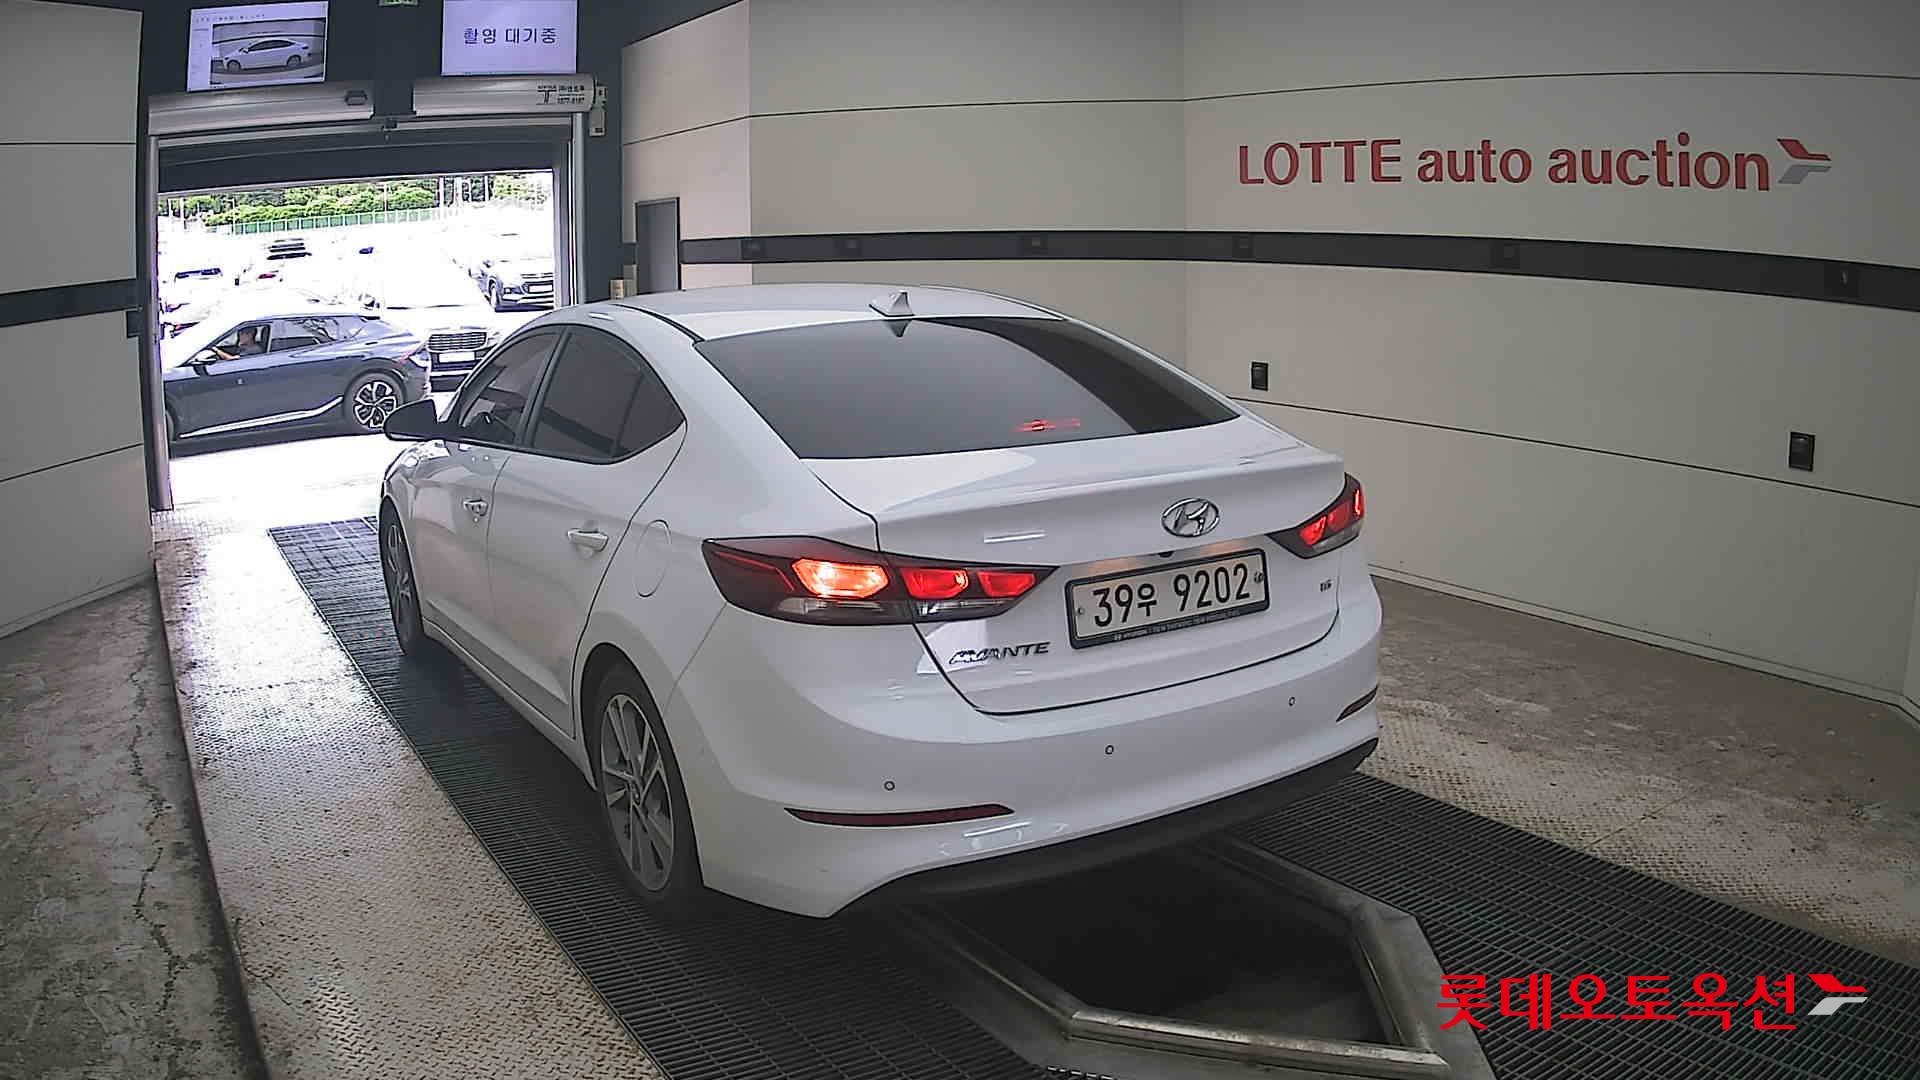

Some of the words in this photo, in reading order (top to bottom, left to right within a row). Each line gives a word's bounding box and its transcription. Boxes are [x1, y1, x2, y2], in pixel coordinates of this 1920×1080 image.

[464, 28, 498, 44] 촬영
[505, 26, 558, 44] 대기중
[1239, 138, 1402, 185] LOTTE
[1417, 140, 1532, 184] auto
[1548, 133, 1771, 191] auction
[1092, 583, 1157, 627] 39우
[1174, 563, 1250, 612] 9202
[948, 641, 1051, 664] AVANTE
